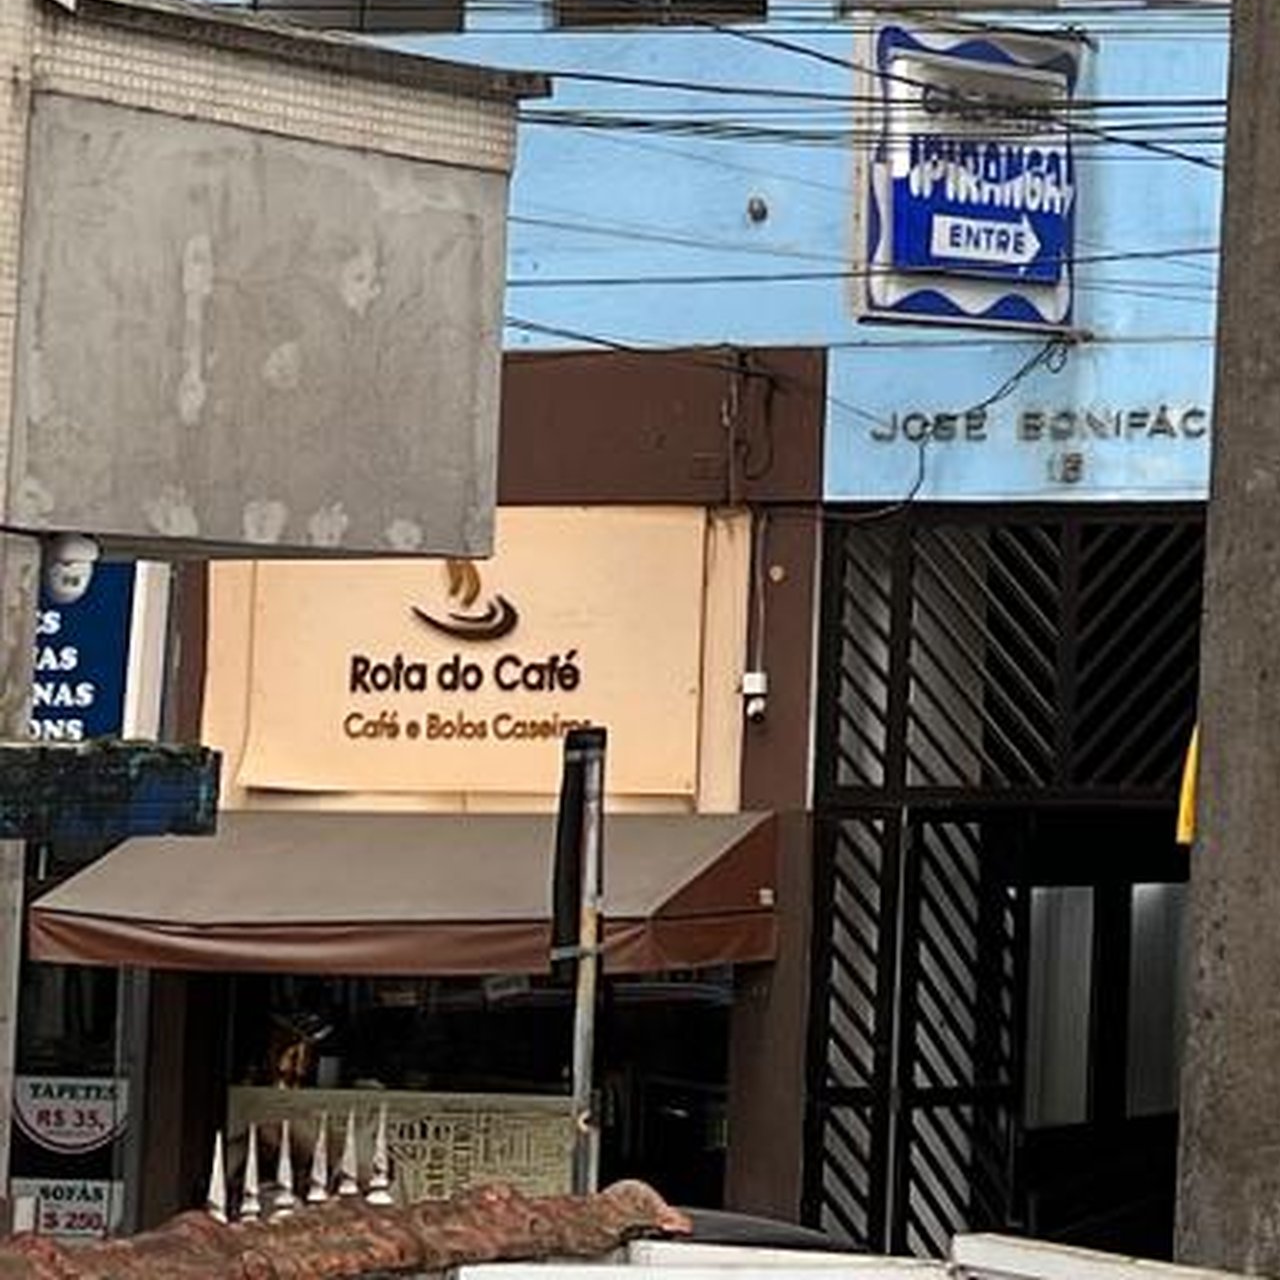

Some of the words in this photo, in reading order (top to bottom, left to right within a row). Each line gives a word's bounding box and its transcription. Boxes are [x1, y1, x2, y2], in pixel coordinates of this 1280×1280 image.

[950, 224, 1026, 255] ENTRE
[350, 653, 427, 694] Rota
[437, 654, 484, 692] do
[493, 649, 581, 693] Café
[343, 710, 400, 739] Café
[405, 720, 421, 739] e
[426, 710, 488, 740] Bolos
[30, 1082, 118, 1101] TAPETES
